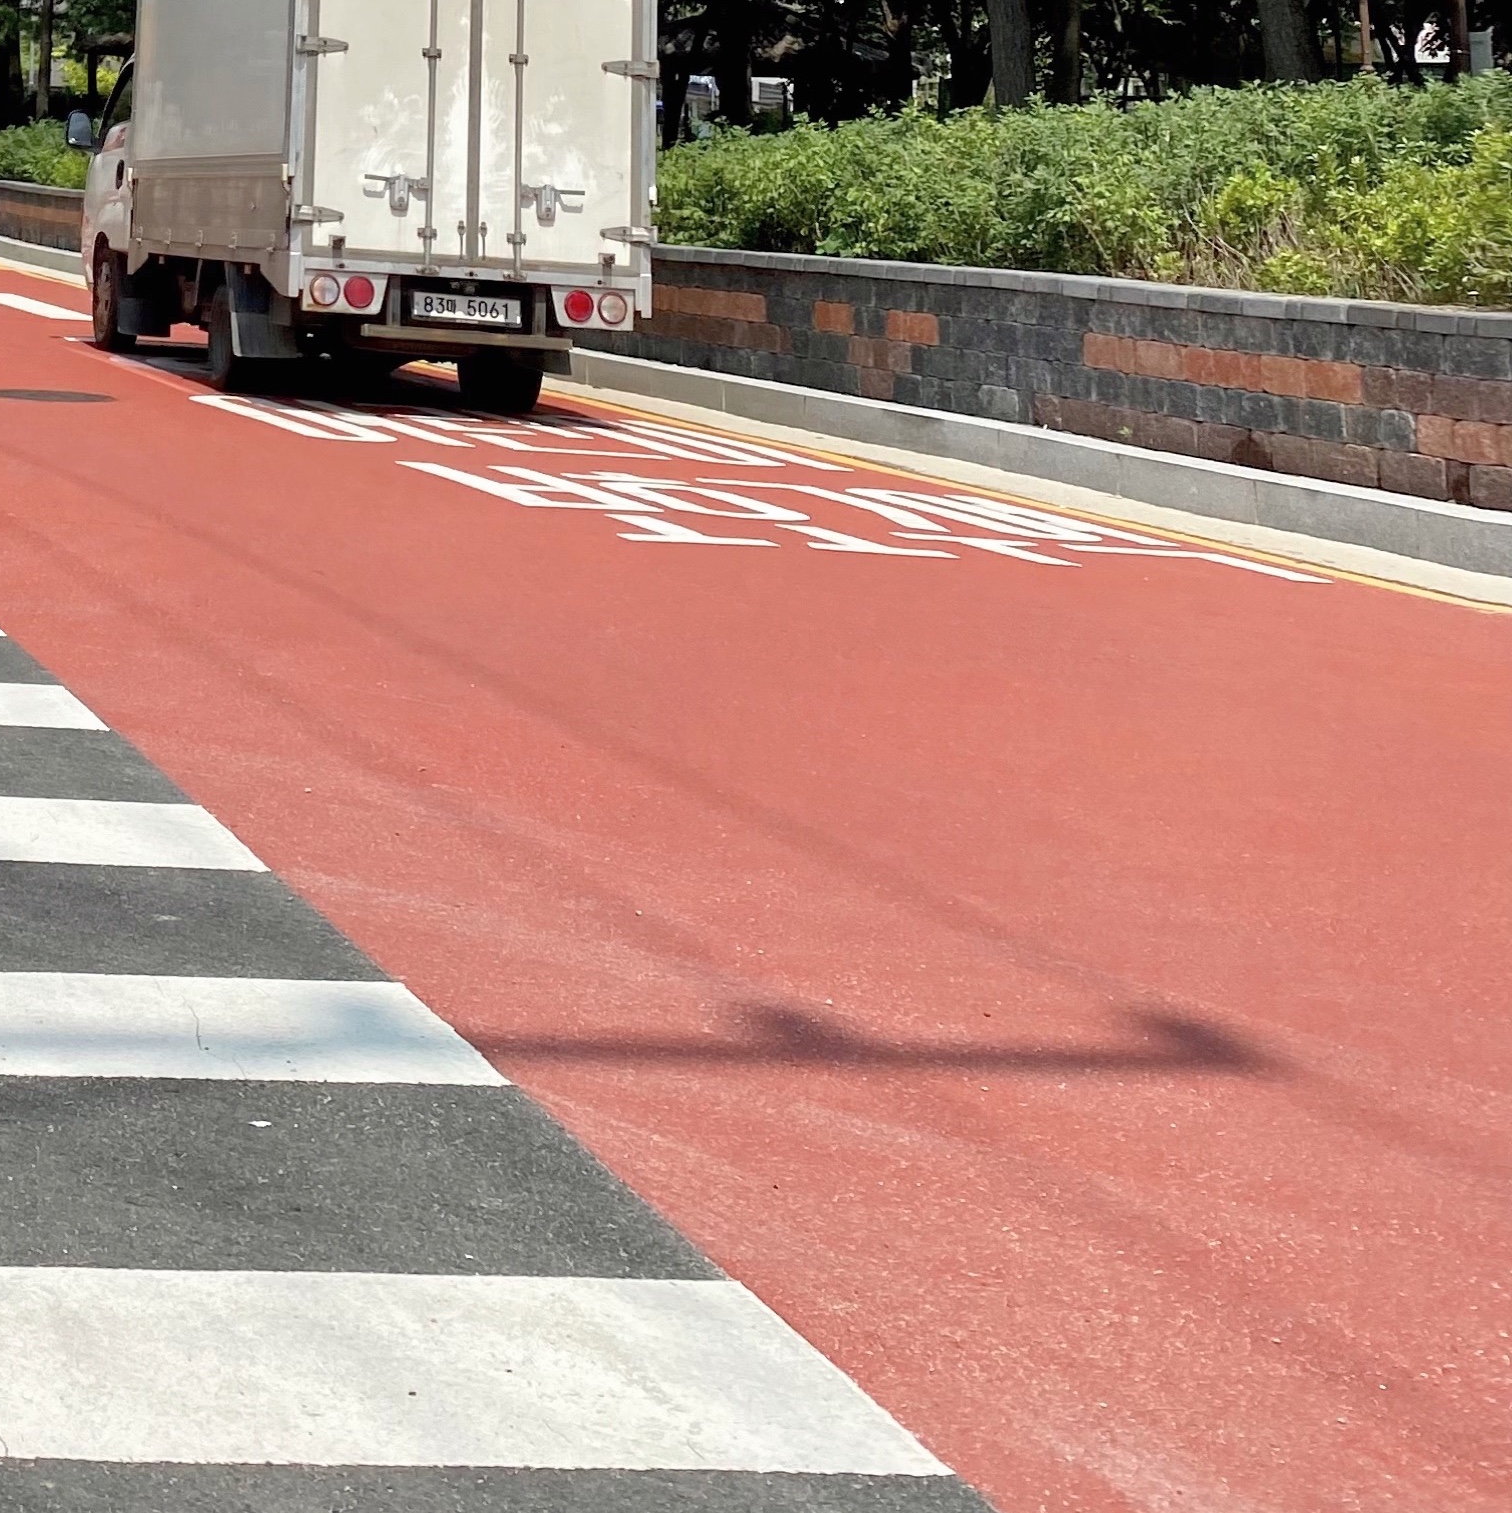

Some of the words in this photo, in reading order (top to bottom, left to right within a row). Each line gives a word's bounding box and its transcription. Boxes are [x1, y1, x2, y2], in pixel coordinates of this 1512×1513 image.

[467, 299, 509, 320] 5061
[187, 394, 854, 472] 어린이
[393, 461, 1335, 584] 보호구역
